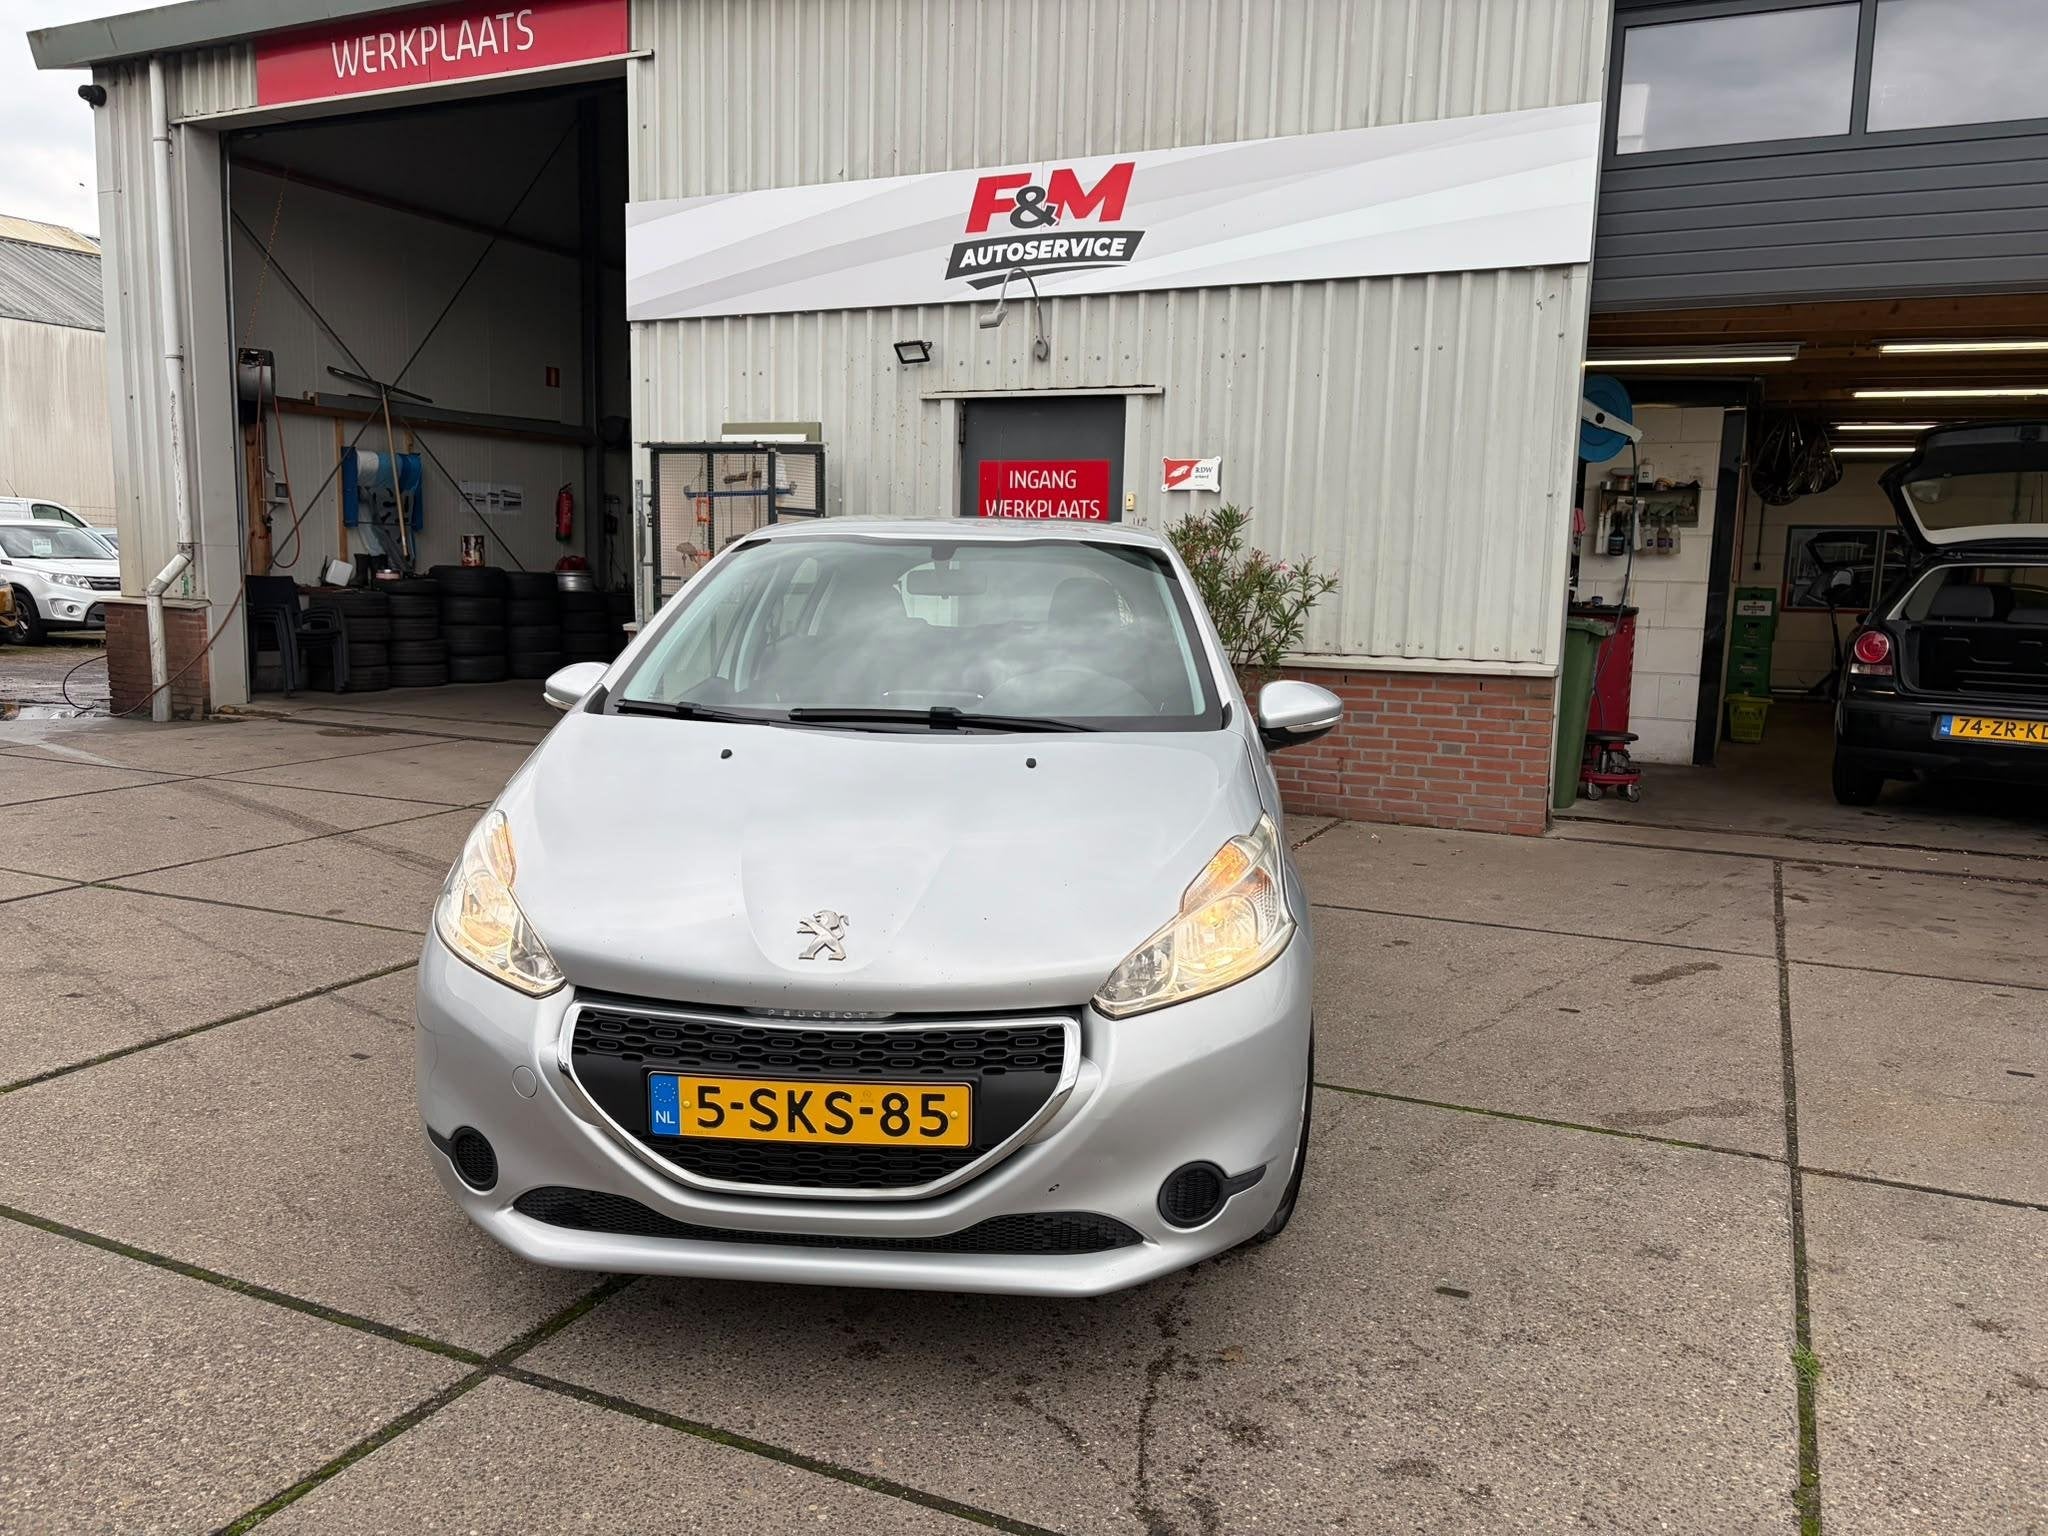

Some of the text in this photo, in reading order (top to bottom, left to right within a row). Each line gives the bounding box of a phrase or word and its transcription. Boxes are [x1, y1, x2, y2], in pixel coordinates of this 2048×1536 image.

[331, 9, 534, 78] WERKPLAATS
[965, 162, 1135, 233] F&M
[959, 237, 1126, 268] AUTOSERVICE
[1009, 470, 1077, 489] INGANG
[985, 499, 1100, 519] WERKPLAATS
[767, 1008, 867, 1019] PEUGEOT
[655, 1109, 676, 1124] NL
[696, 1085, 949, 1137] 5-SKS-85
